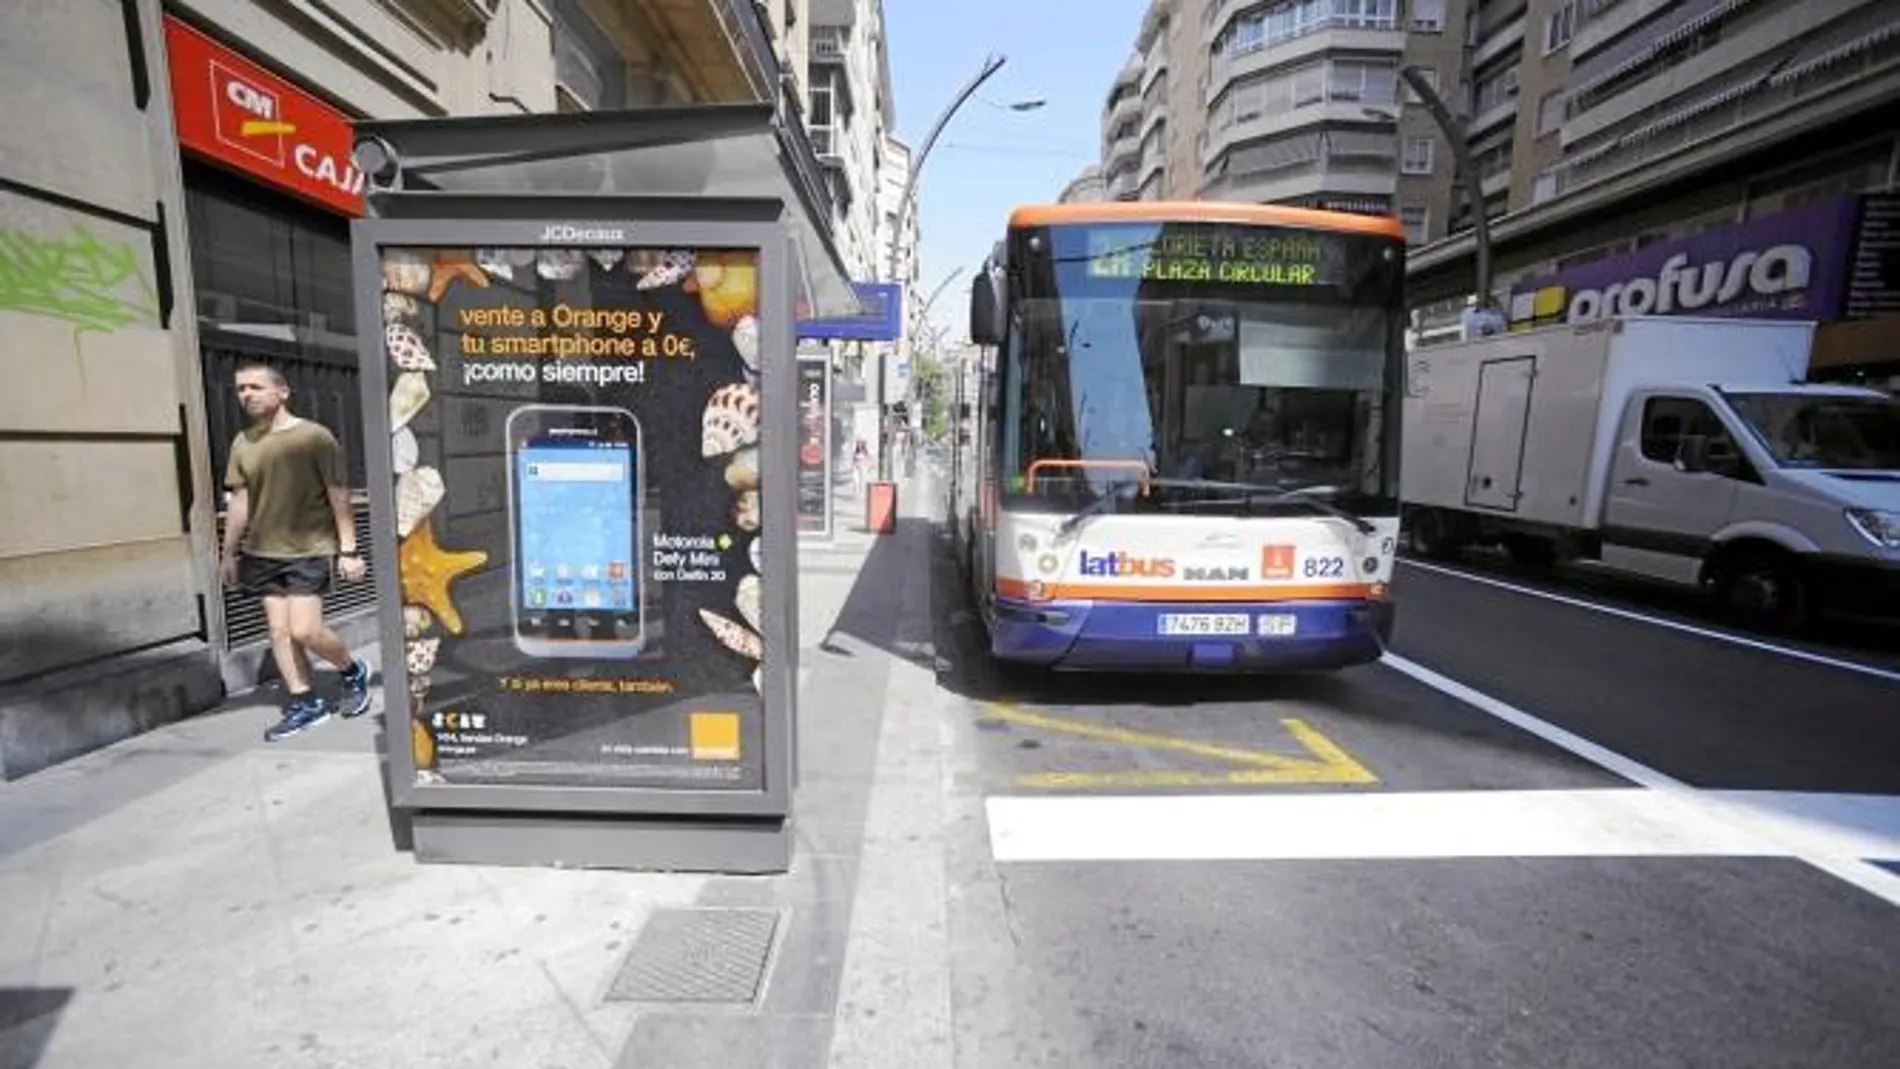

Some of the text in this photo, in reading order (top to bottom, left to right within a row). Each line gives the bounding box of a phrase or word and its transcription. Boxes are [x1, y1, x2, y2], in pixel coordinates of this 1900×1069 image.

[540, 227, 622, 241] JCDecaux
[1142, 257, 1210, 281] PLAZA
[1219, 261, 1318, 285] CIRCULAR
[1567, 243, 1814, 325] profusa
[460, 303, 663, 333] vente a Orange y
[461, 334, 485, 354] tu
[491, 333, 636, 358] smartphone
[642, 340, 657, 356] a
[463, 361, 646, 386] ¡como siempre!
[653, 533, 715, 550] Motorola
[653, 551, 687, 569] Defy
[1079, 550, 1344, 581] latbus MAN 822
